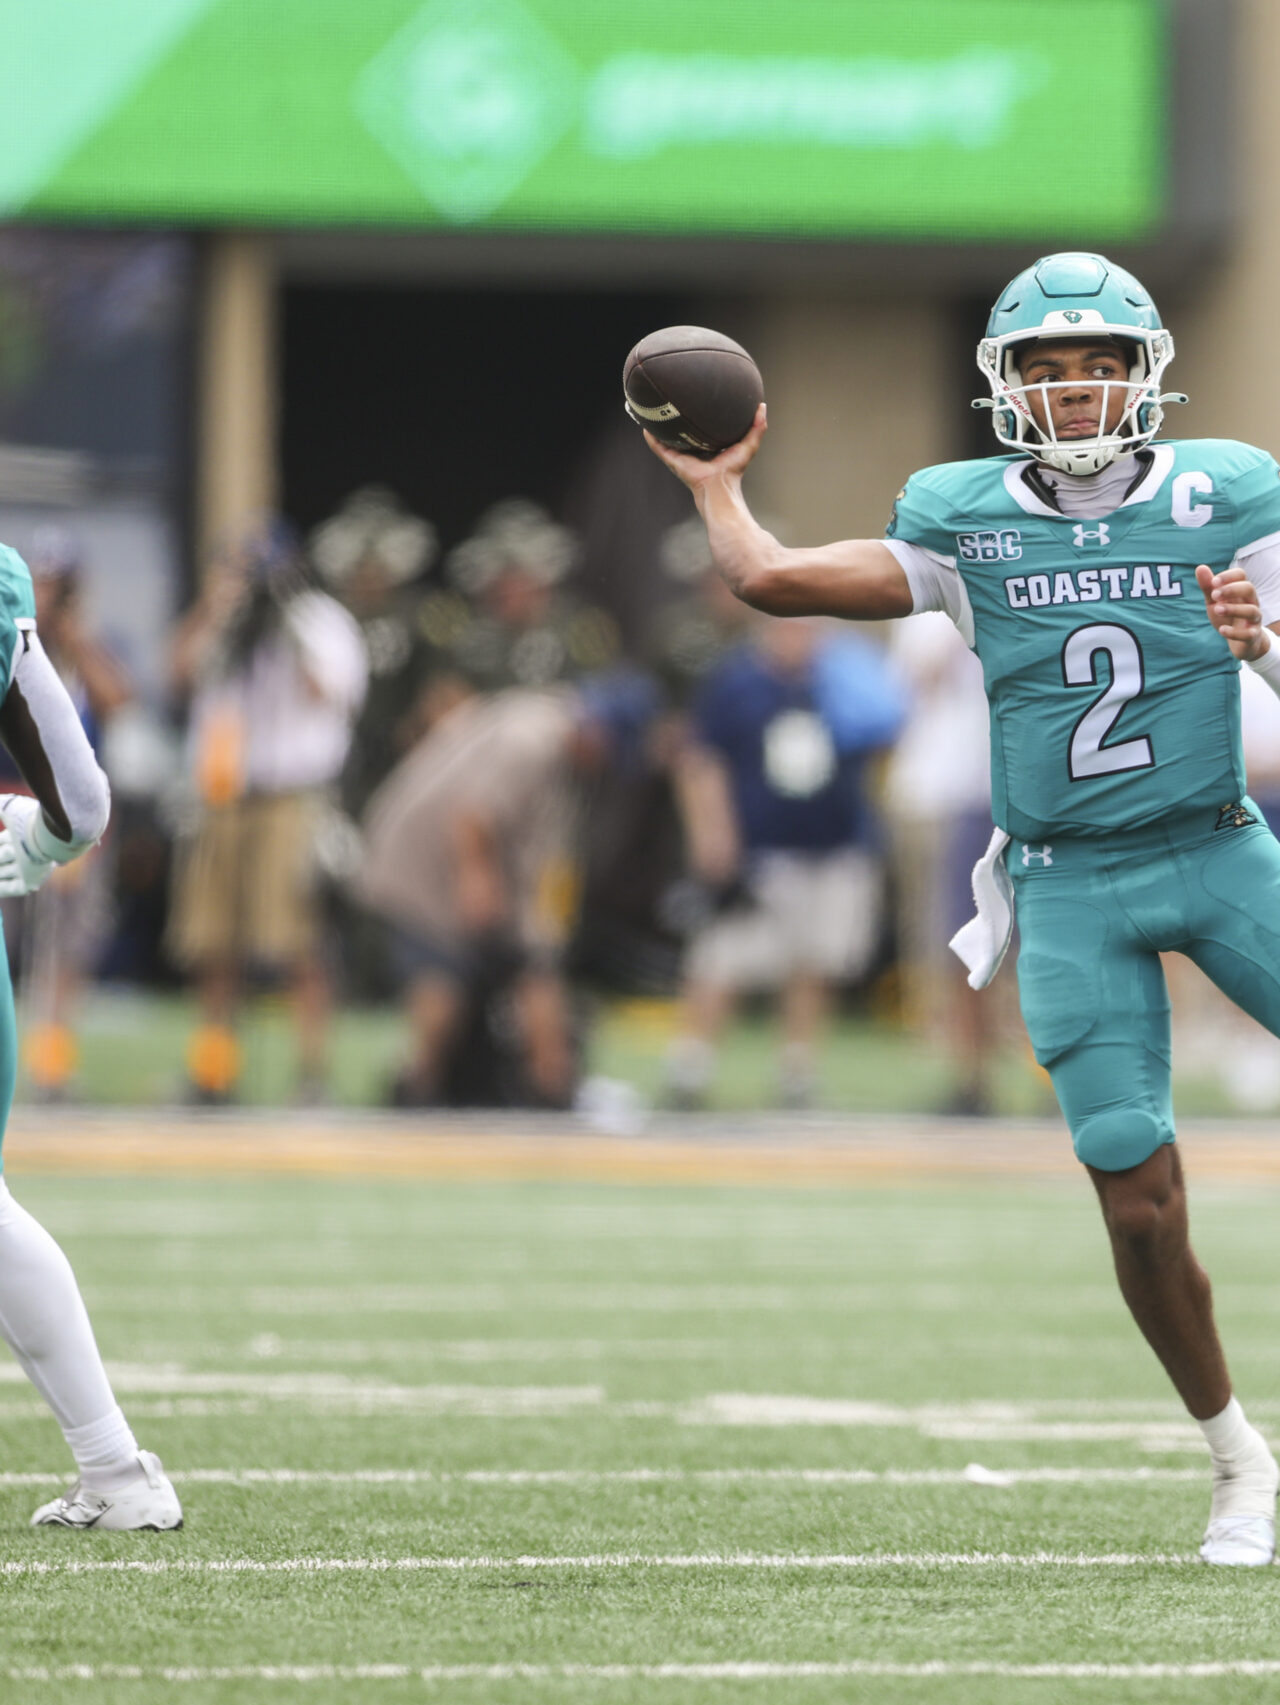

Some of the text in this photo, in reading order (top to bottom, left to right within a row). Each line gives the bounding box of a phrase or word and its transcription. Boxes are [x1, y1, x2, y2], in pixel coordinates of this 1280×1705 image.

[1171, 471, 1213, 527] C
[956, 529, 1023, 561] SBC
[1004, 564, 1182, 608] COASTAL
[1061, 621, 1156, 783] 2
